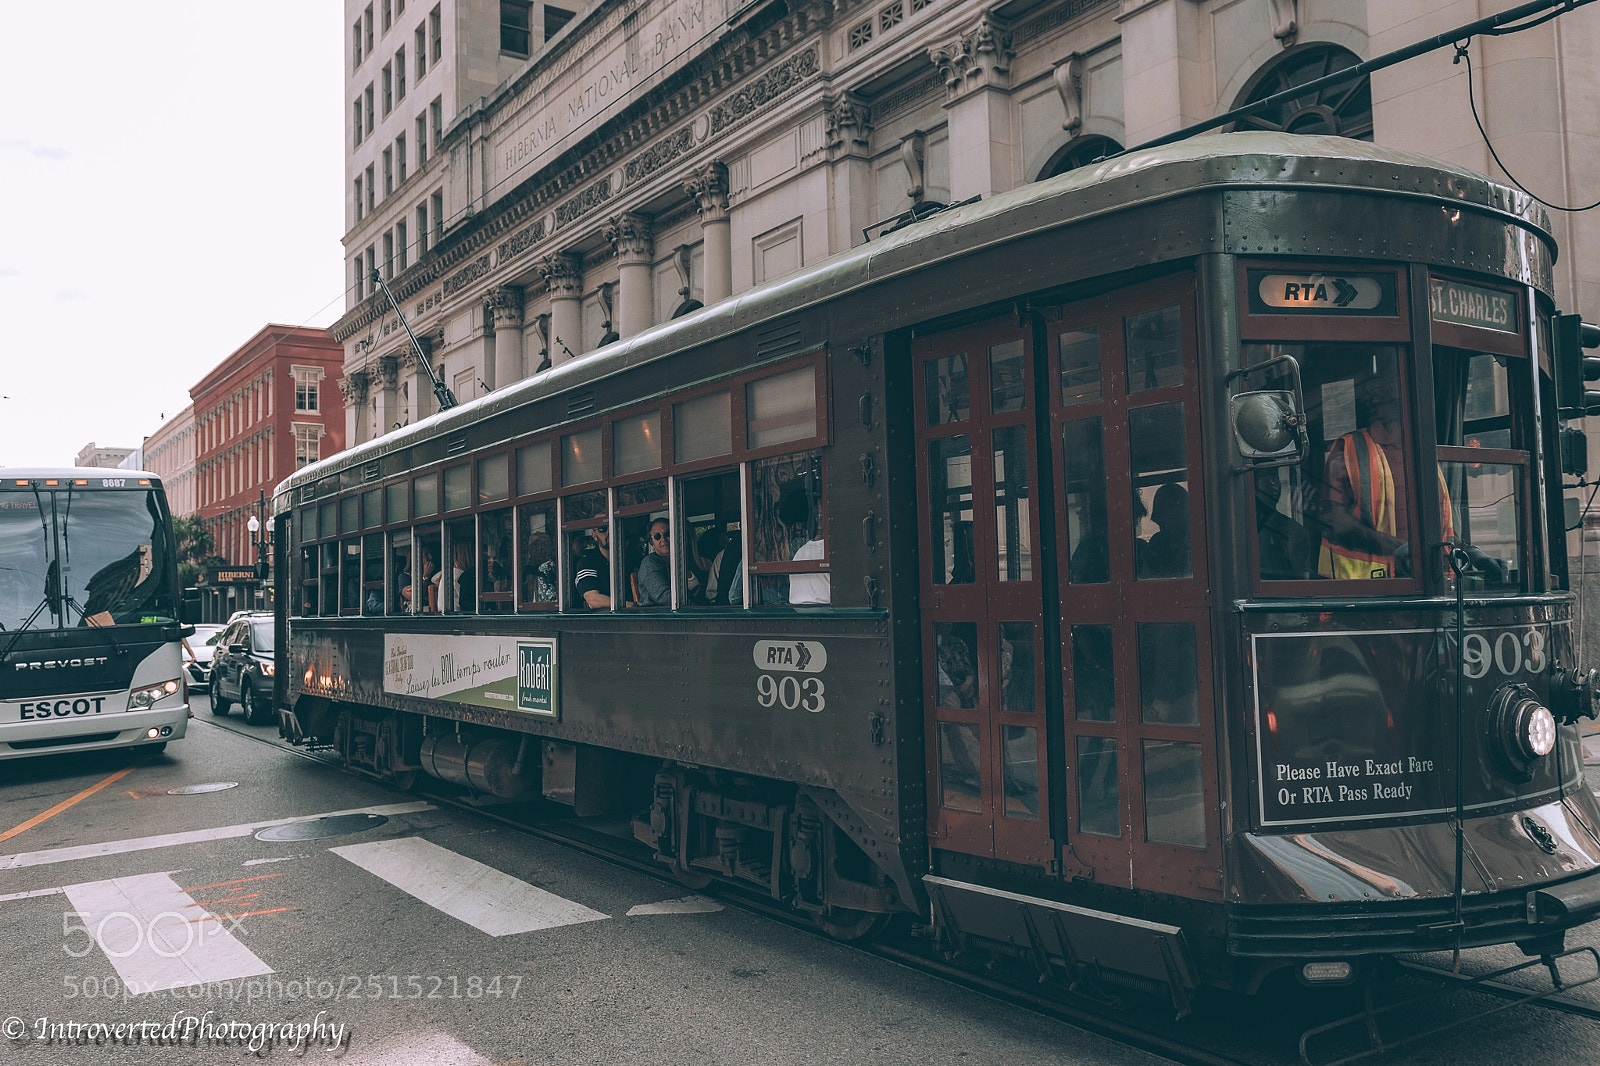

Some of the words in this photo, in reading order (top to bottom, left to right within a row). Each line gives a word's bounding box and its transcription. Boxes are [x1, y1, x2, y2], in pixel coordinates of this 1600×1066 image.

[505, 117, 557, 170] HIBERNIA
[567, 53, 639, 122] NATIONAL
[654, 2, 703, 57] BANK
[1284, 282, 1328, 301] RTA
[1449, 288, 1508, 325] CHARLES
[102, 479, 126, 488] 8687
[11, 501, 39, 509] TRAVEL
[15, 657, 108, 671] PREVOST
[766, 646, 793, 665] RTA
[1462, 631, 1546, 679] 903
[406, 673, 430, 699] Laissez
[431, 667, 440, 687] les
[456, 659, 481, 685] temps
[757, 674, 826, 713] 903
[20, 697, 106, 720] ESCOT
[1276, 764, 1321, 781] Please
[1326, 761, 1360, 778] Have
[1365, 759, 1403, 776] Exact
[1408, 756, 1434, 773] Fare
[1278, 788, 1297, 806] Or
[1302, 786, 1334, 804] RTA
[1338, 785, 1368, 802] Pass
[1373, 782, 1413, 800] Ready
